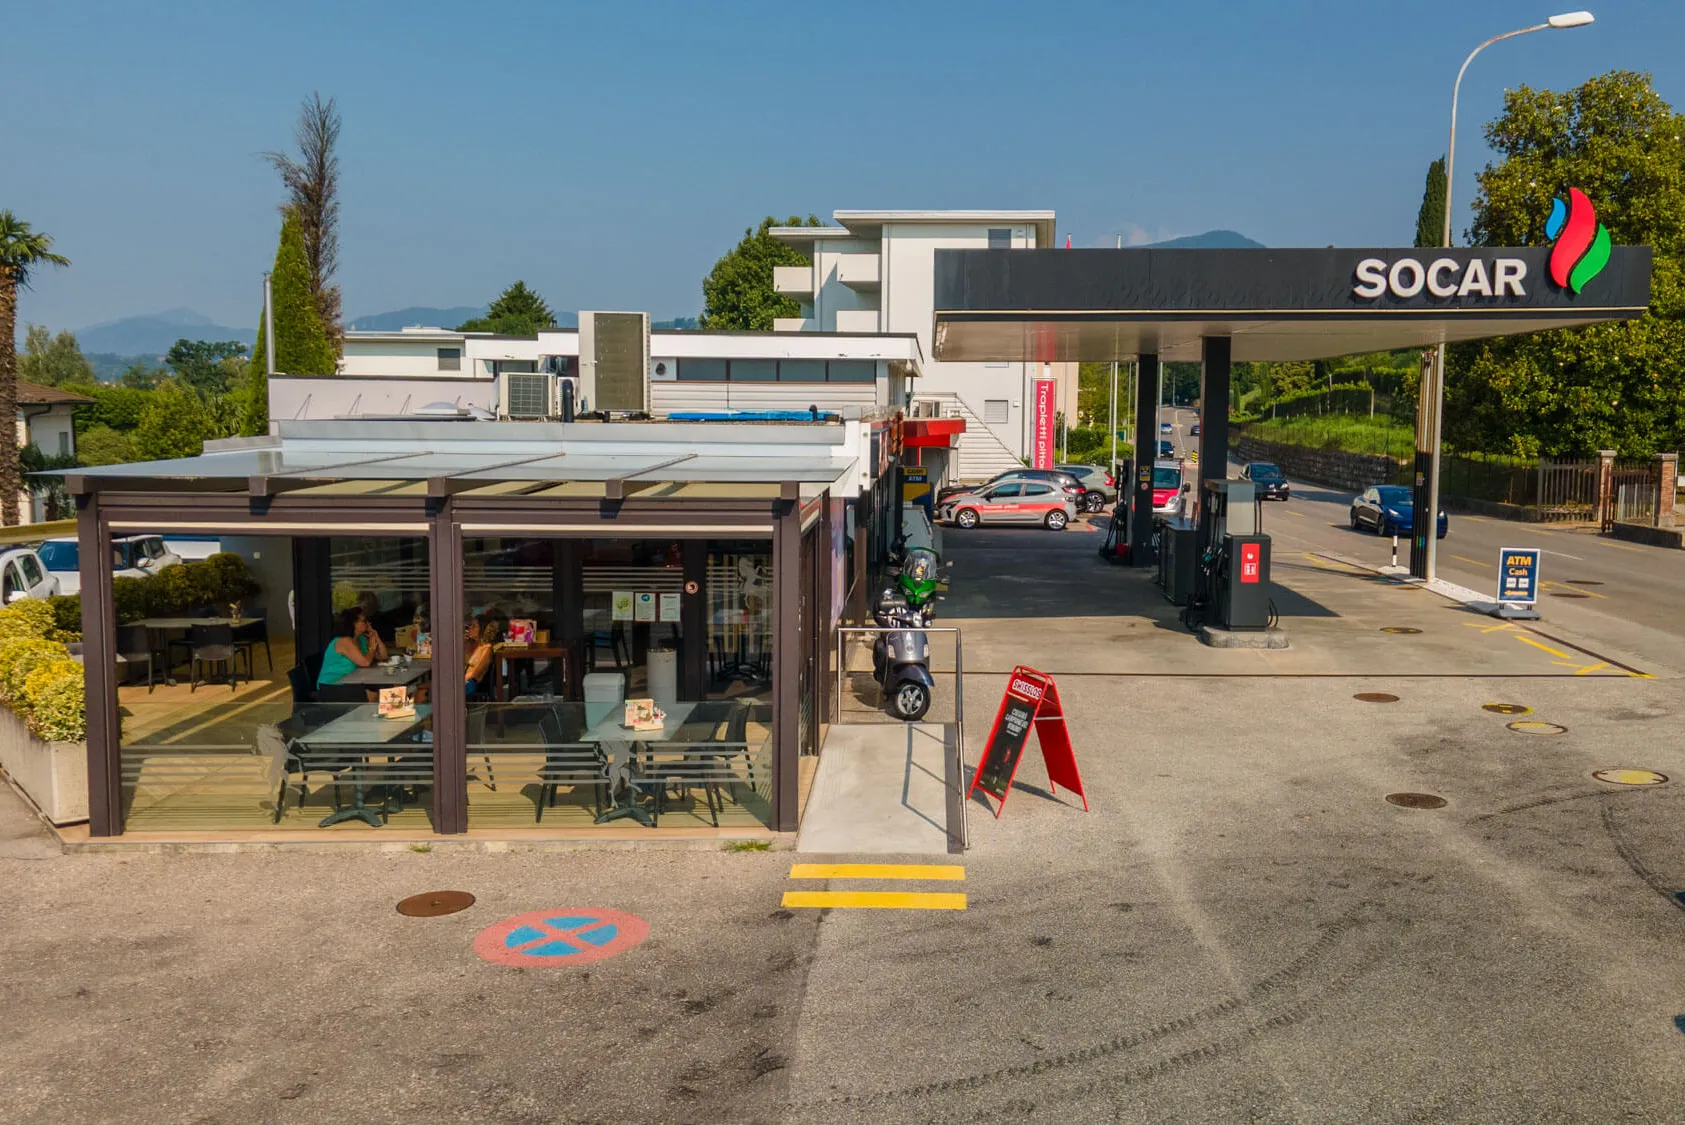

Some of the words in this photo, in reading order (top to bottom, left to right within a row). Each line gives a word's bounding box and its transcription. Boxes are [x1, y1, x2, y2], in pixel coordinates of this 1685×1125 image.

[1353, 258, 1527, 298] SOCAR
[1039, 383, 1049, 439] Trapletti
[1507, 555, 1532, 566] ATM
[1509, 567, 1528, 576] Cash
[1013, 680, 1043, 698] SWISSLOS
